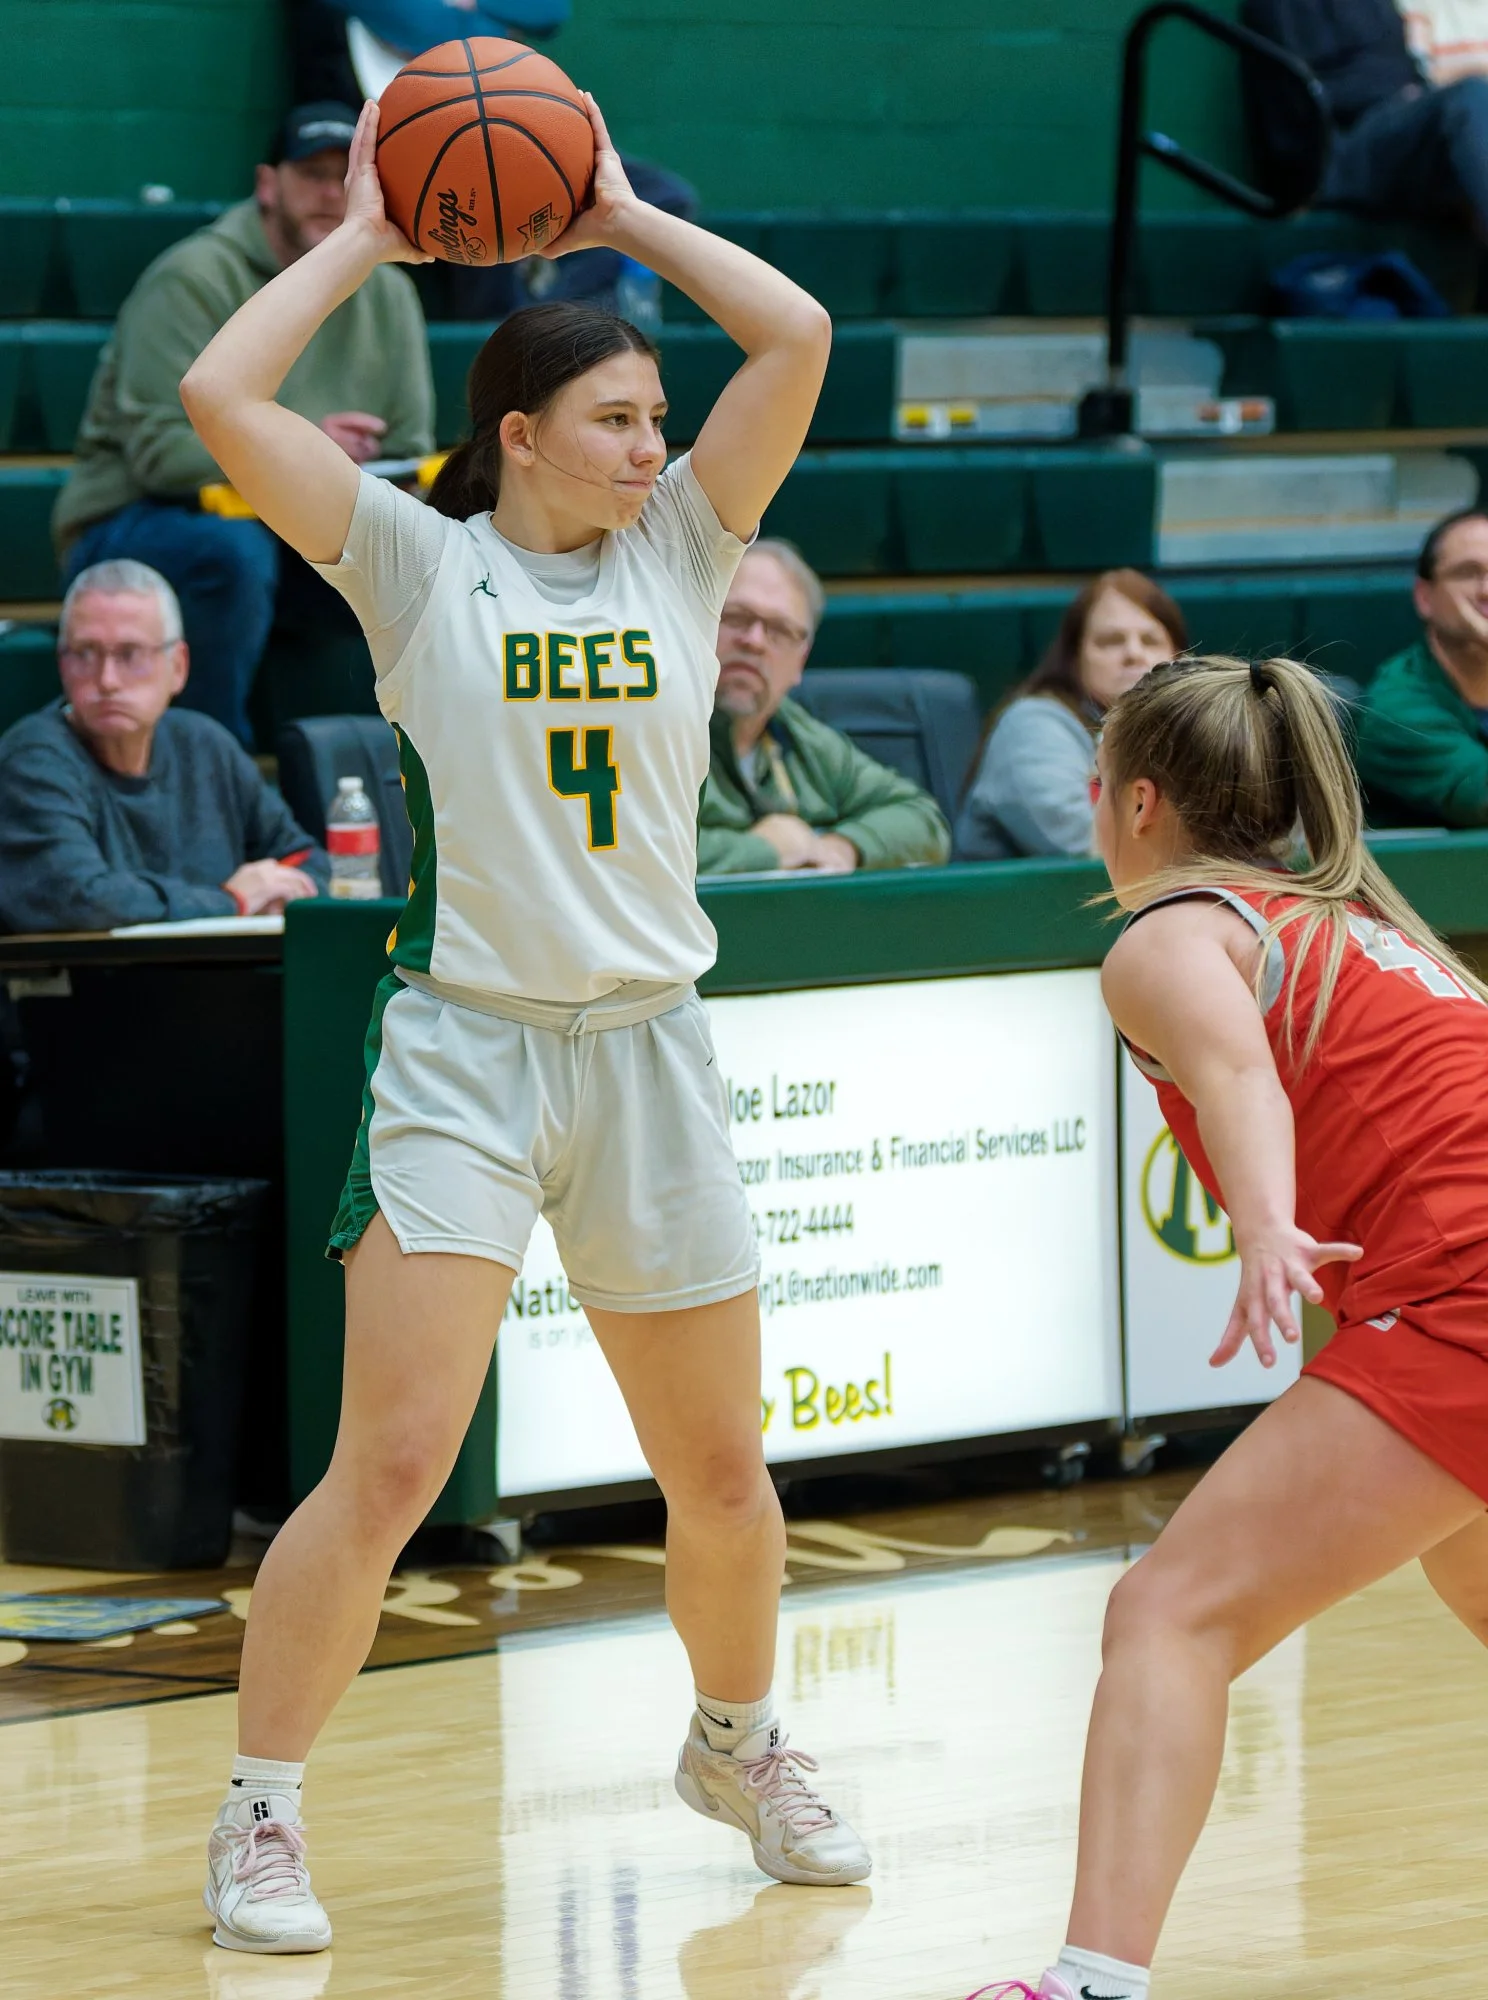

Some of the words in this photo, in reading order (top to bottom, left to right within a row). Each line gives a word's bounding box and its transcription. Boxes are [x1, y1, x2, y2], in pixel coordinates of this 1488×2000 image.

[503, 628, 660, 702] BEES
[545, 725, 623, 852] 4
[772, 1073, 836, 1120] Lazor
[777, 1149, 863, 1181] Insurance
[871, 1138, 883, 1172] &
[890, 1130, 970, 1169] Financial
[975, 1127, 1048, 1161] Services
[1053, 1116, 1087, 1154] LLC
[751, 1202, 854, 1243] -722-4444
[504, 1275, 582, 1320] Natio
[62, 1310, 123, 1355] TABLE
[21, 1352, 42, 1393] IN
[48, 1353, 94, 1396] GYM
[784, 1350, 893, 1431] Bees!
